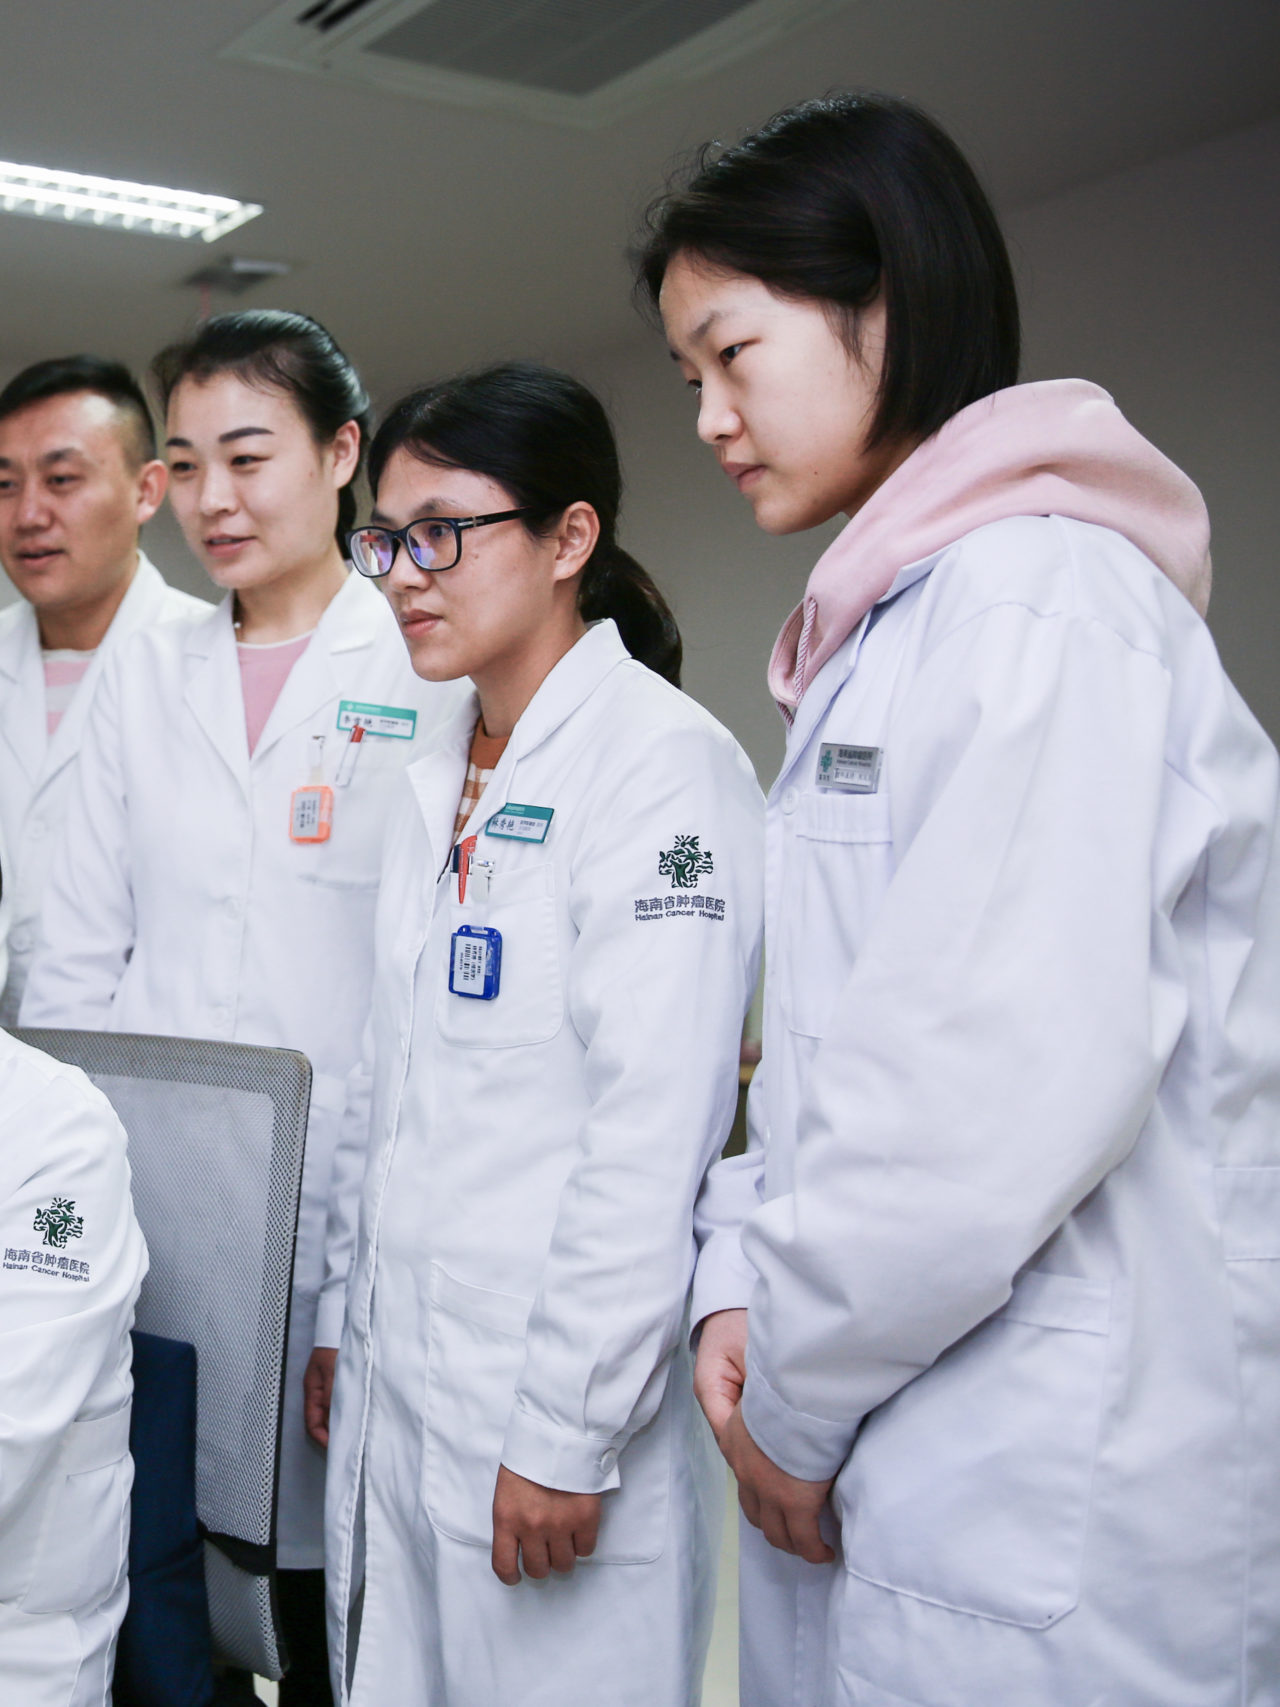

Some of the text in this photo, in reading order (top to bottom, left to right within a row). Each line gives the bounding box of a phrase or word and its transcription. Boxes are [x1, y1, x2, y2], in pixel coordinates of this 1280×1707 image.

[634, 895, 725, 913] 海南省肿瘤医院
[634, 910, 725, 921] Hainan Cancer Hospital
[4, 1248, 90, 1275] 海南省肿瘤医院
[2, 1262, 90, 1282] Hainan Cancer Hospital
